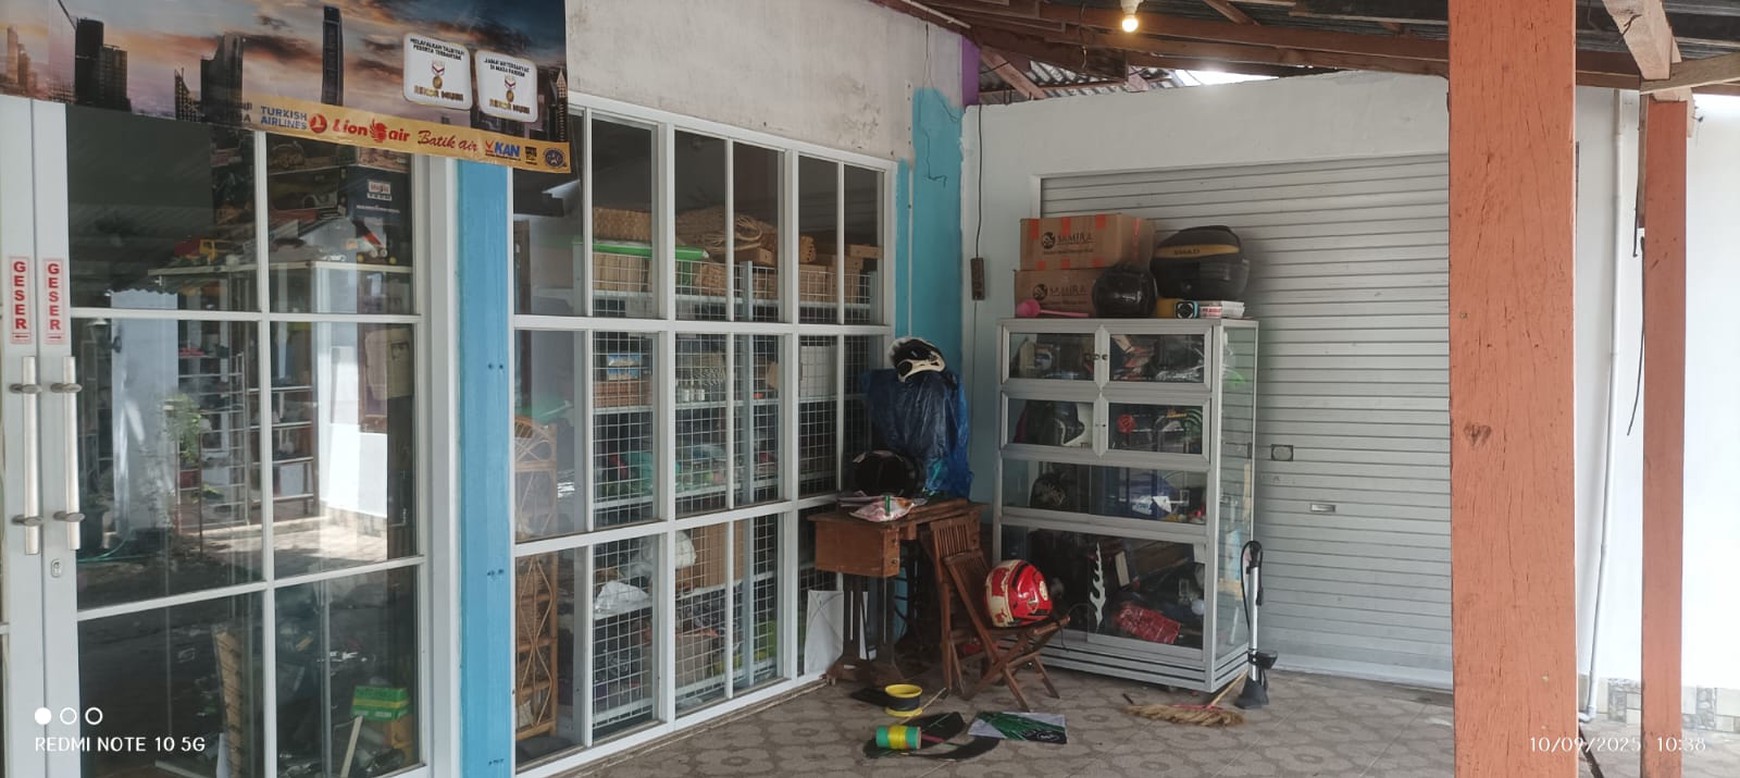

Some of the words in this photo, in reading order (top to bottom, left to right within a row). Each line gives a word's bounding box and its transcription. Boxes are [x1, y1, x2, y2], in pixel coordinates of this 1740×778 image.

[260, 105, 307, 121] TURKISH
[260, 115, 307, 130] AIRLINES
[332, 118, 368, 137] Lion
[388, 128, 411, 142] air
[417, 130, 457, 148] Batik
[458, 139, 479, 152] air
[494, 141, 521, 157] KAN
[13, 261, 27, 330] GESER
[47, 263, 61, 331] GESER
